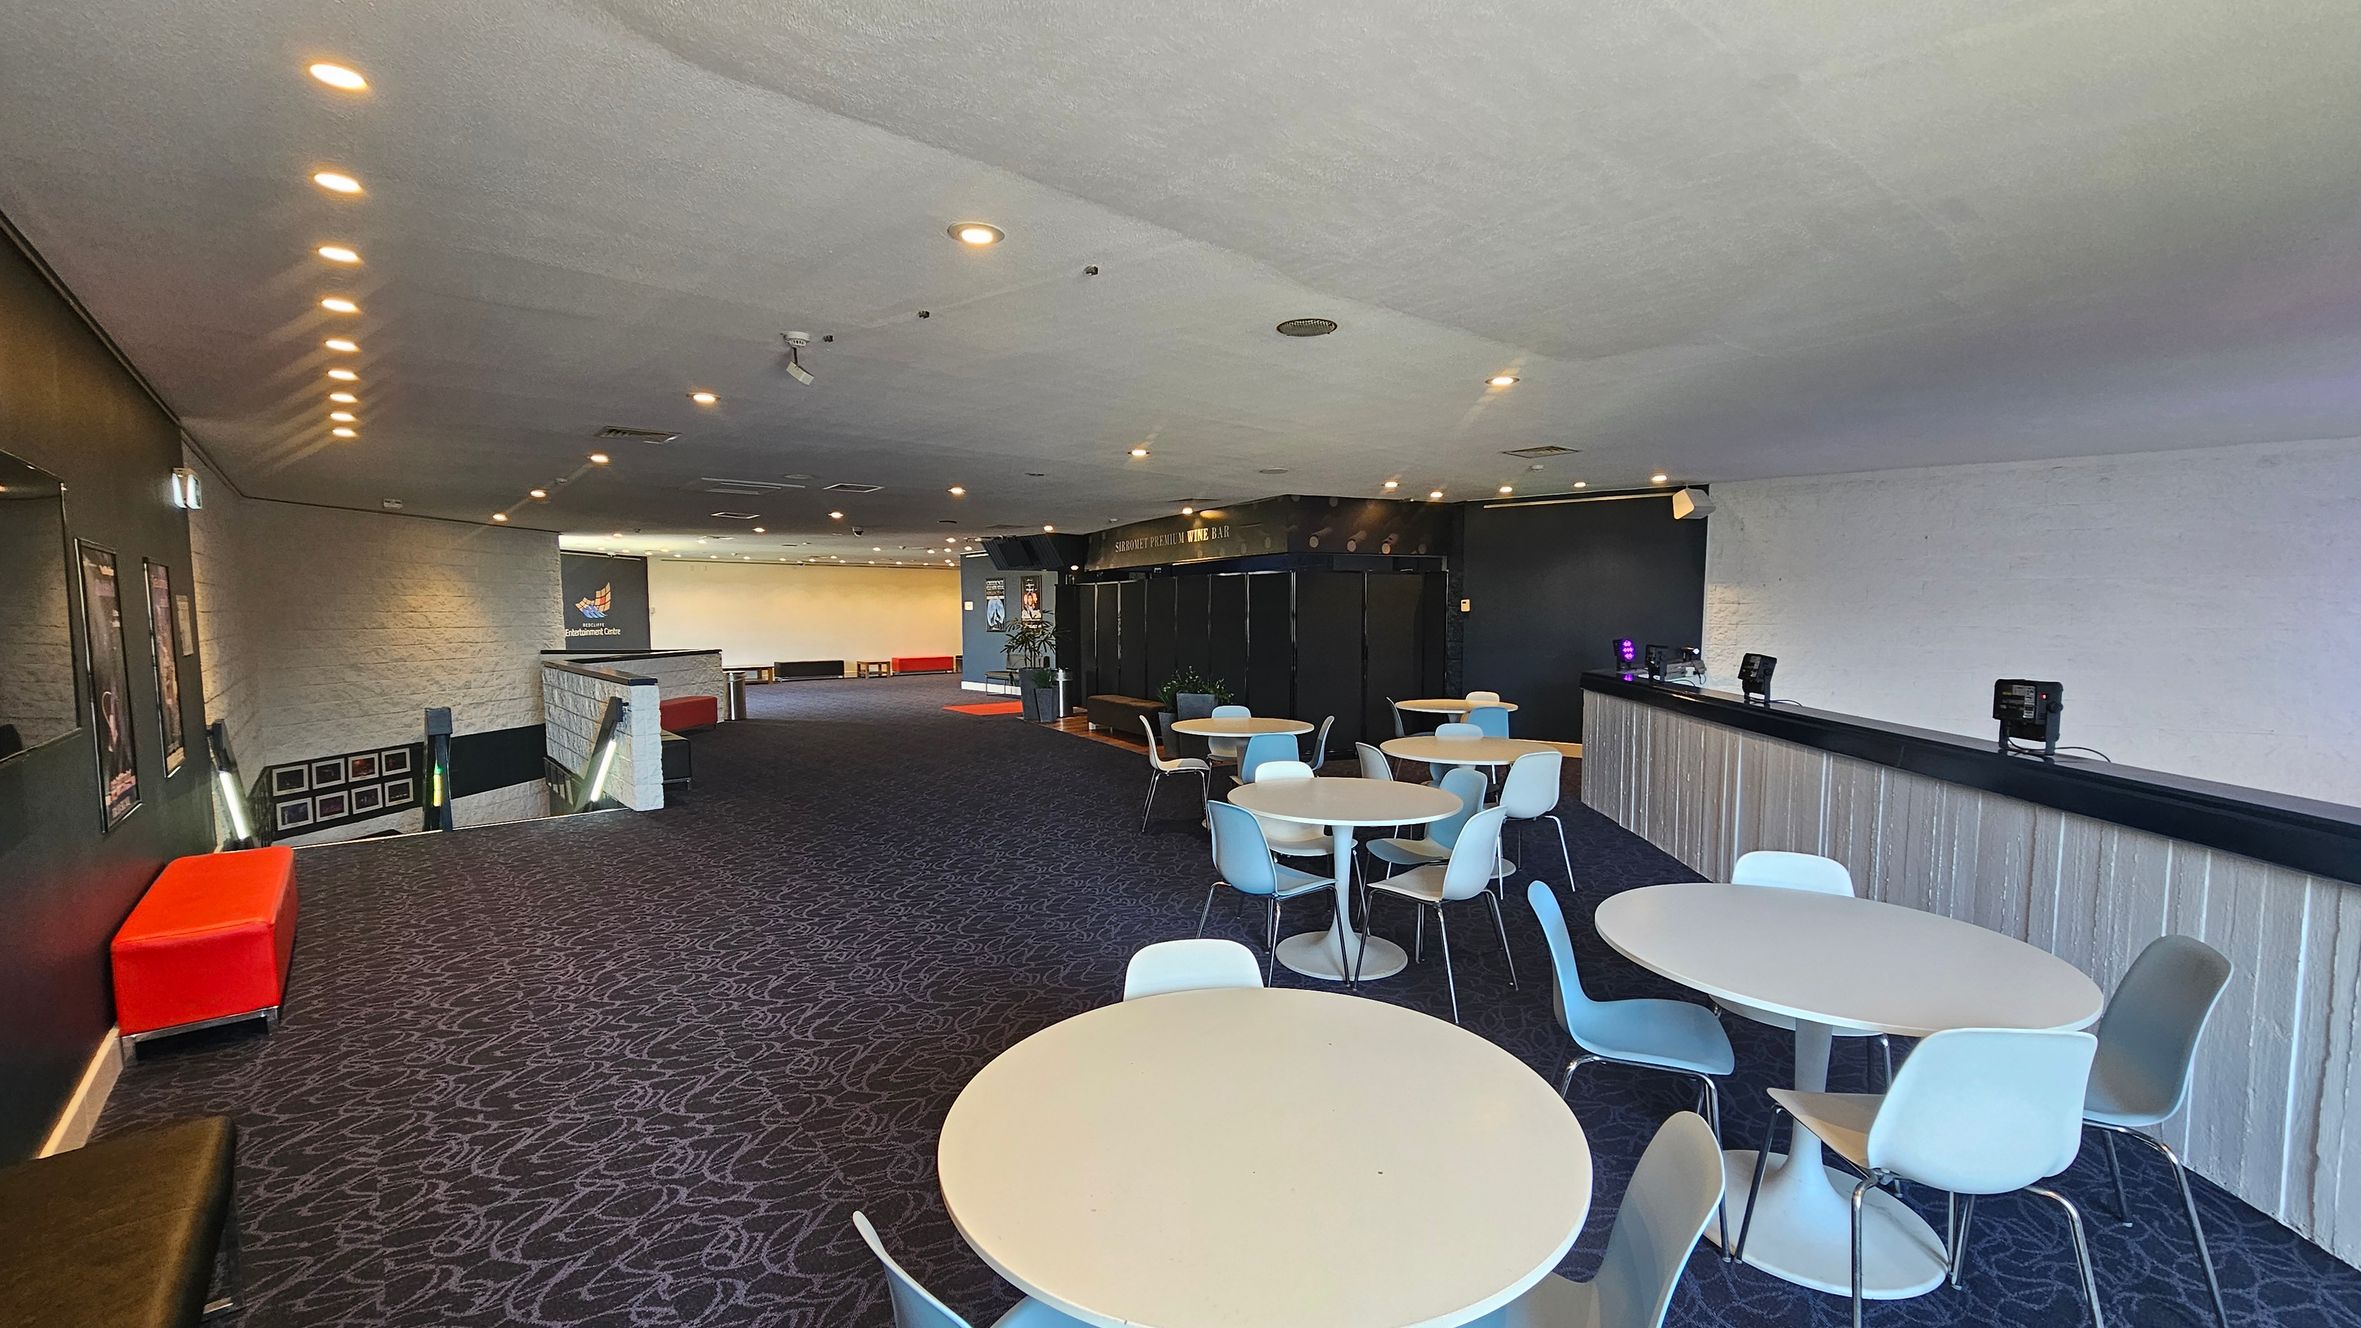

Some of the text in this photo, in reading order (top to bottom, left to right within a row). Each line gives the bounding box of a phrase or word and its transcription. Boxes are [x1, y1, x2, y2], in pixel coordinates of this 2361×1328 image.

[1115, 525, 1230, 553] SIRROMET PREMIUM WINE BAR
[565, 627, 621, 637] Entertainment Centre
